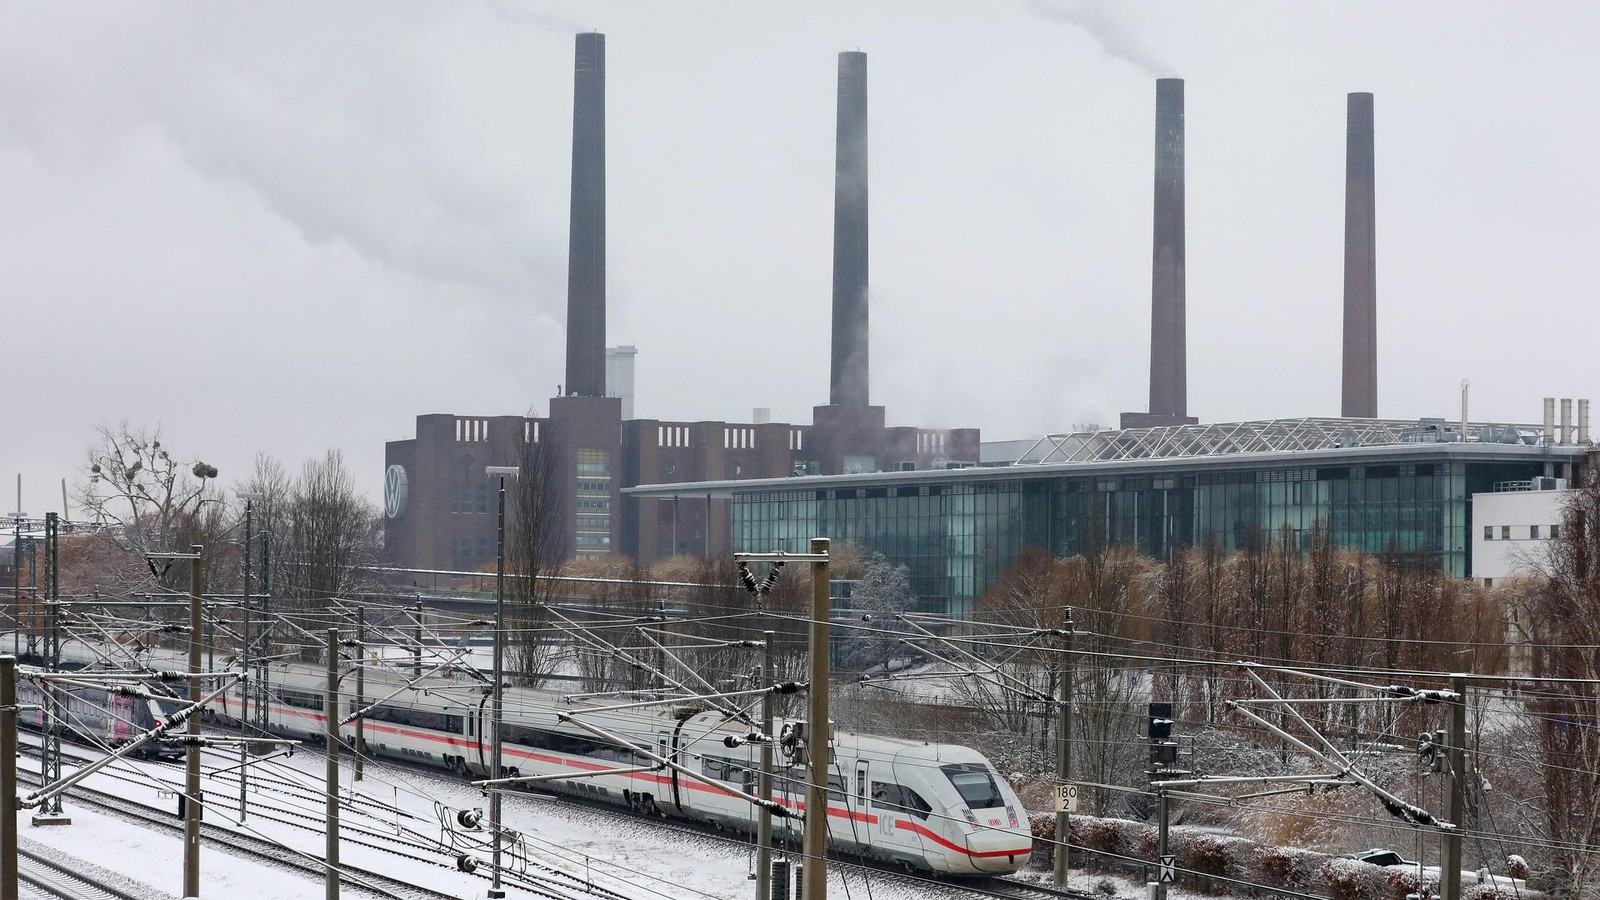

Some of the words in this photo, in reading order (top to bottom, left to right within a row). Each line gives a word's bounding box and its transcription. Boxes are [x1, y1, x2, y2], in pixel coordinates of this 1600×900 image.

[385, 465, 400, 514] VW
[1057, 787, 1077, 798] 180
[1063, 798, 1070, 809] 2
[879, 814, 894, 837] ICE
